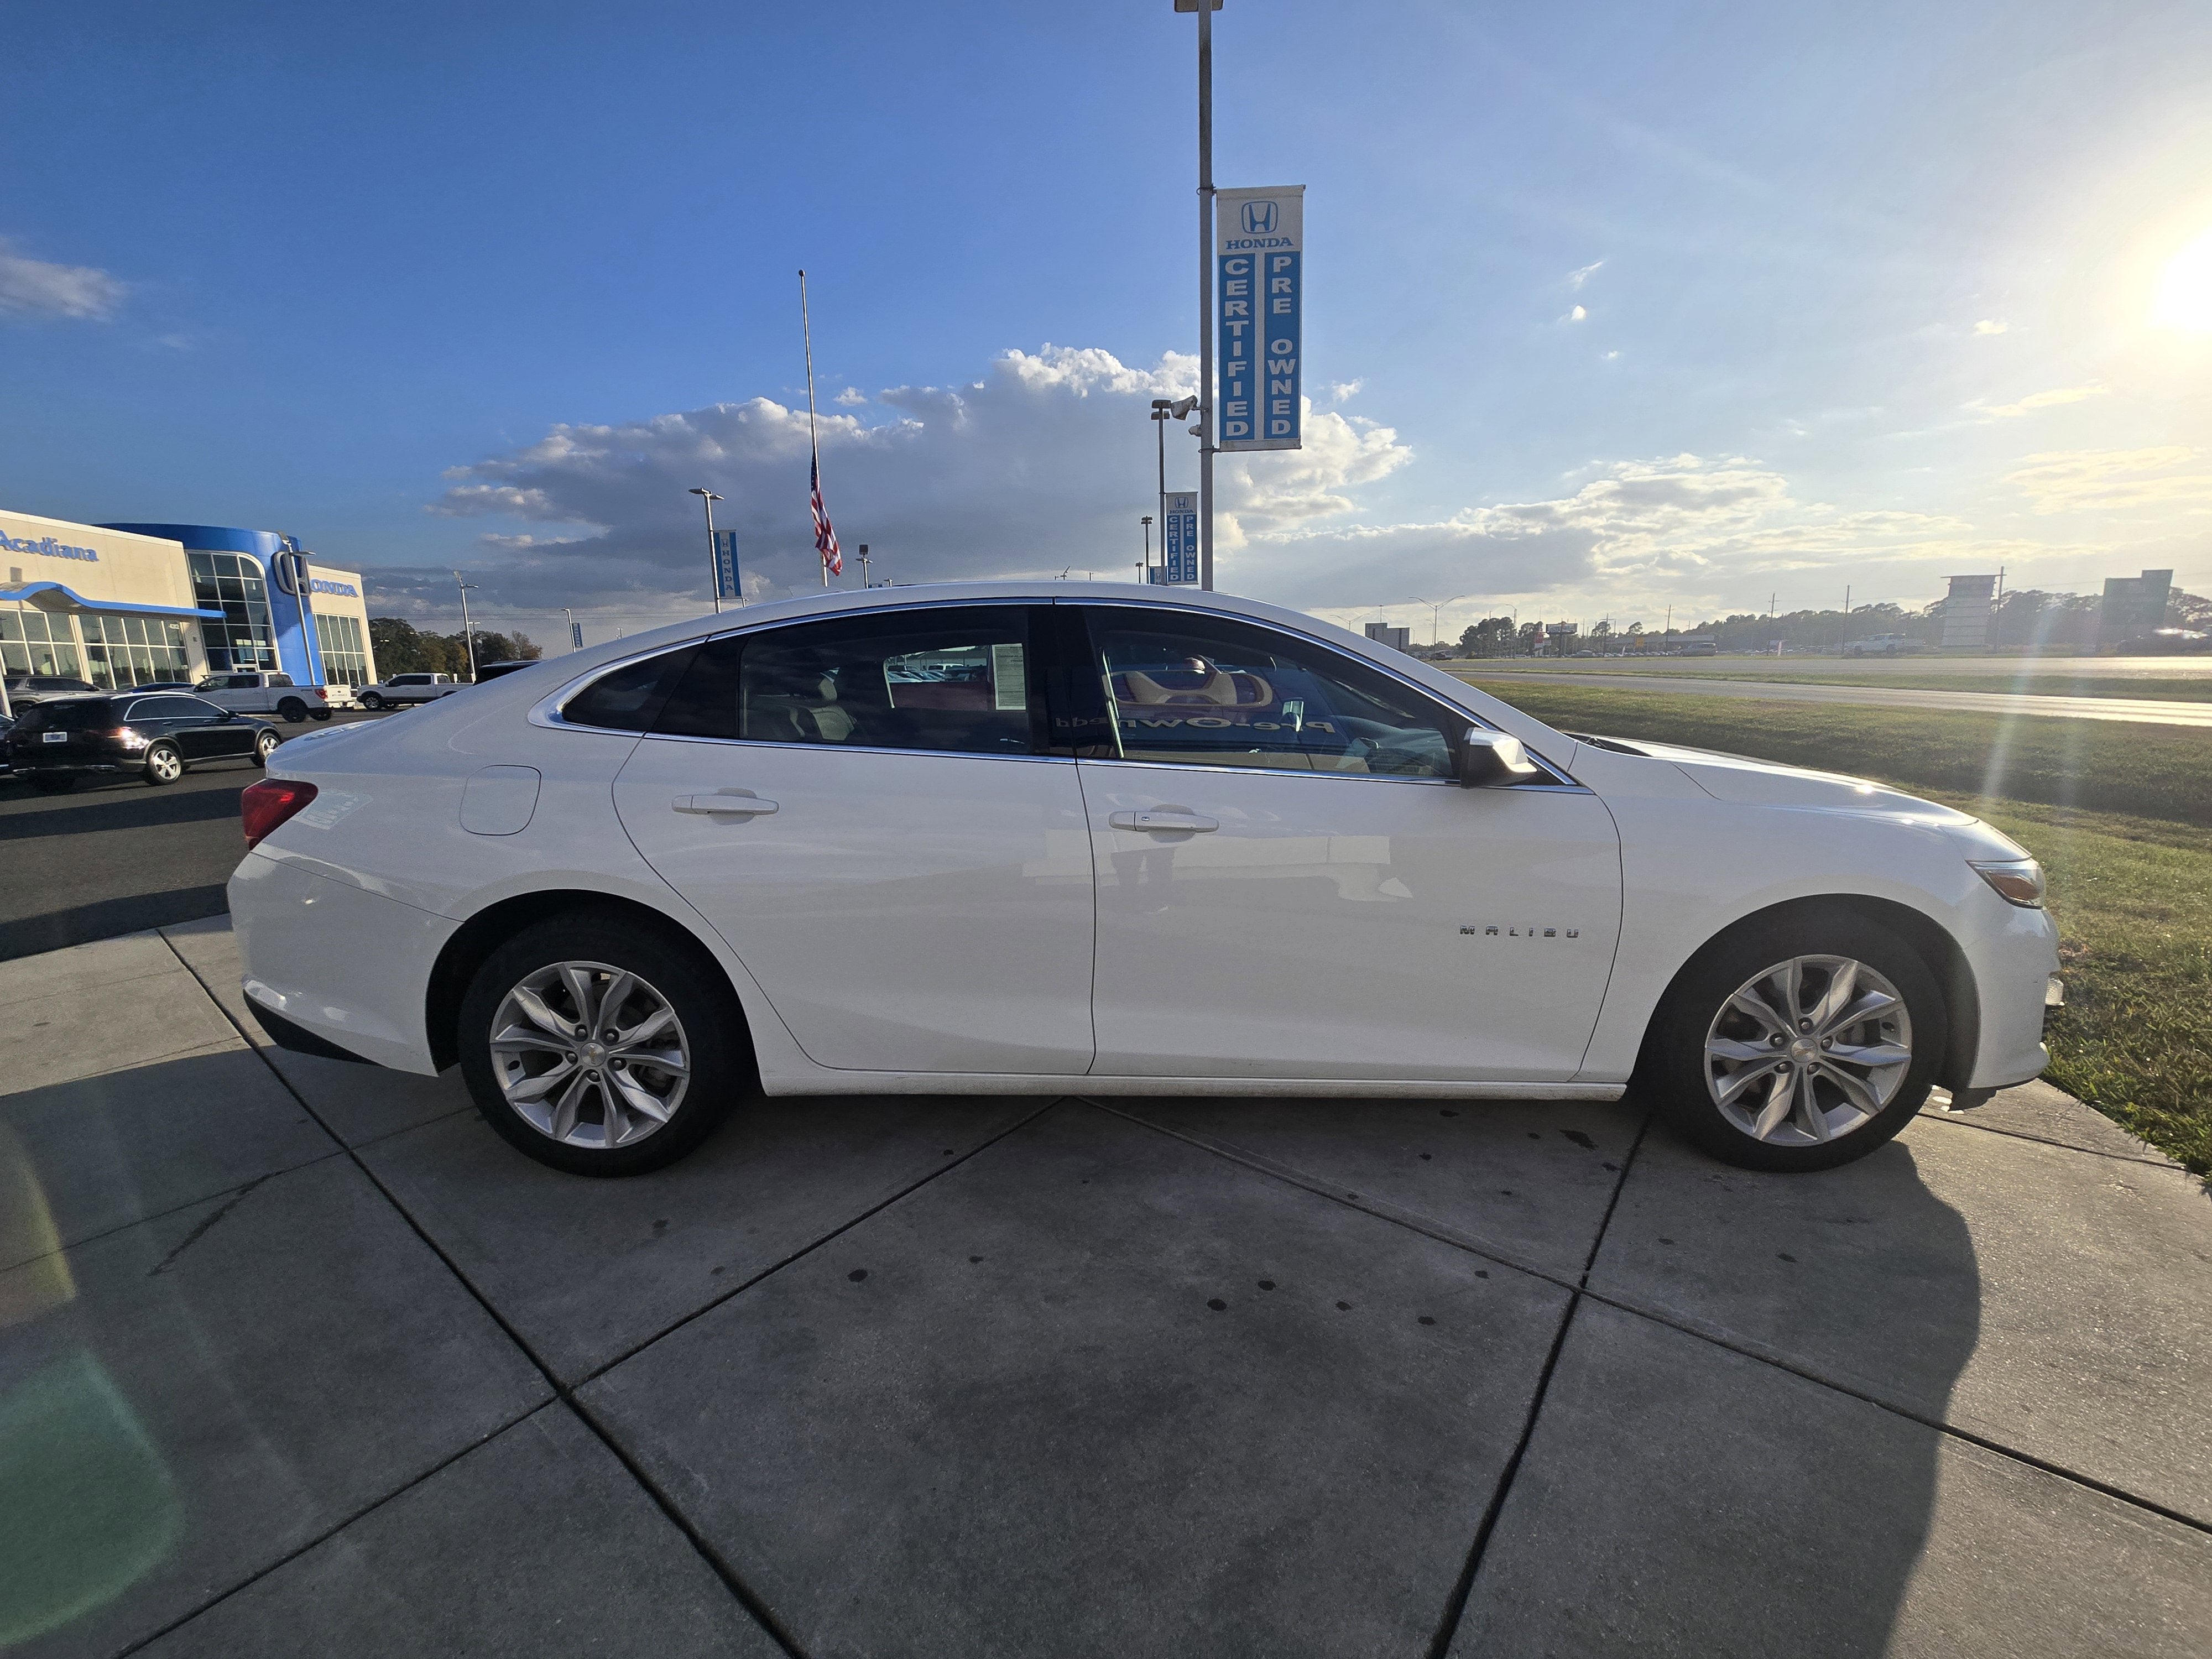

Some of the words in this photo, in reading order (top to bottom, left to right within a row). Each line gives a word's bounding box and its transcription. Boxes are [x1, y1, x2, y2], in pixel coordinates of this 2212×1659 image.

[1226, 237, 1293, 249] HONDA
[1272, 256, 1292, 314] PRE
[1225, 258, 1249, 436] CERTIFIED
[1267, 338, 1296, 435] OWNED
[1169, 517, 1179, 580] CERTIFIED
[1185, 545, 1196, 580] OWNED
[311, 579, 358, 598] ONDA
[722, 550, 733, 591] HONDA
[1460, 925, 1579, 938] MALIBU
